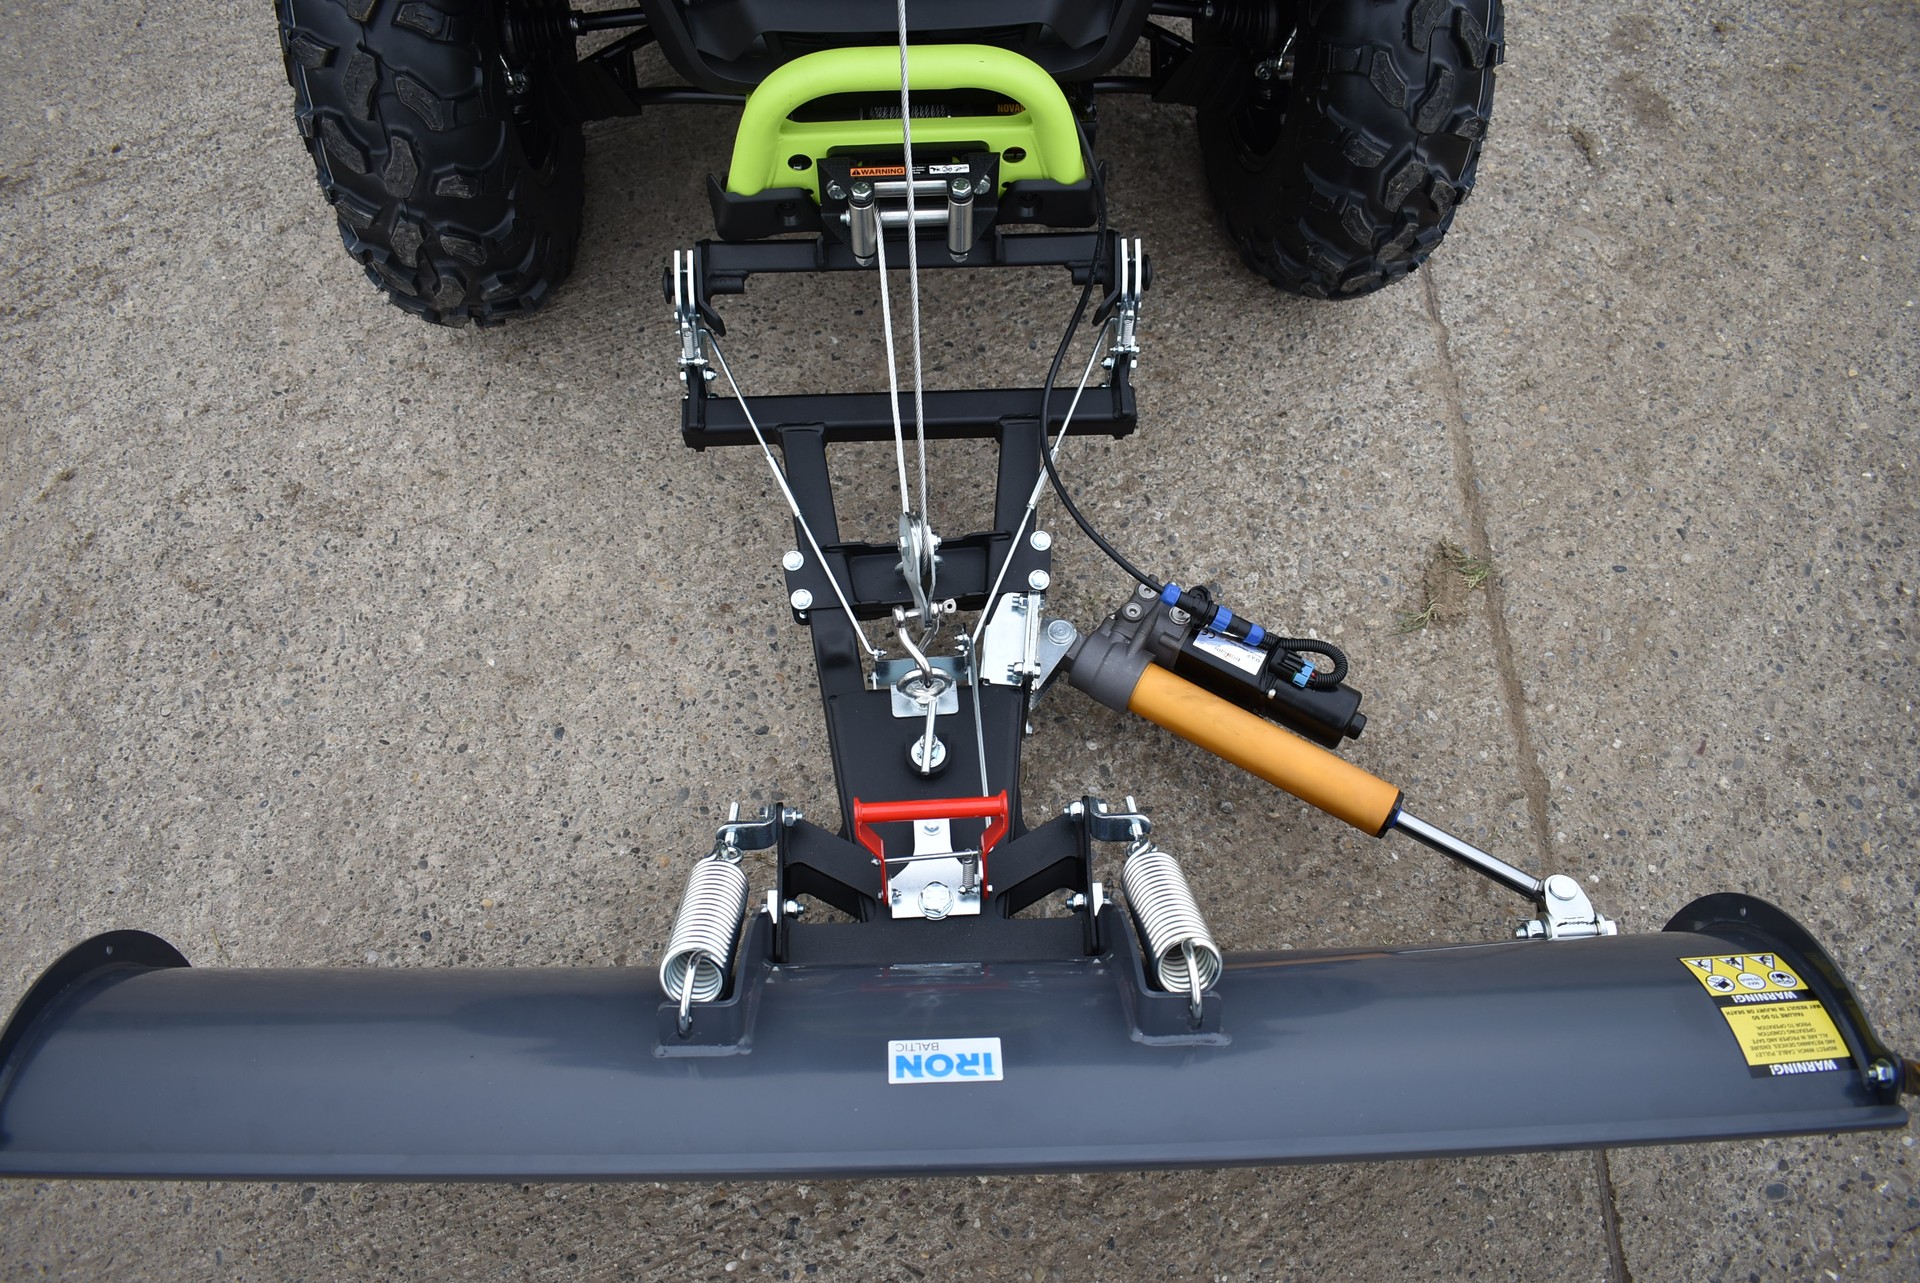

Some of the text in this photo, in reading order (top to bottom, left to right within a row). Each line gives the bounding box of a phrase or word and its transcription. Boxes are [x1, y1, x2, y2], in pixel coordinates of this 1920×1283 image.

[860, 167, 904, 175] WARNING
[1731, 991, 1798, 1003] WARNING!
[895, 1042, 939, 1052] BALTIC
[895, 1052, 995, 1078] IRON
[1769, 1059, 1838, 1075] WARNING!
